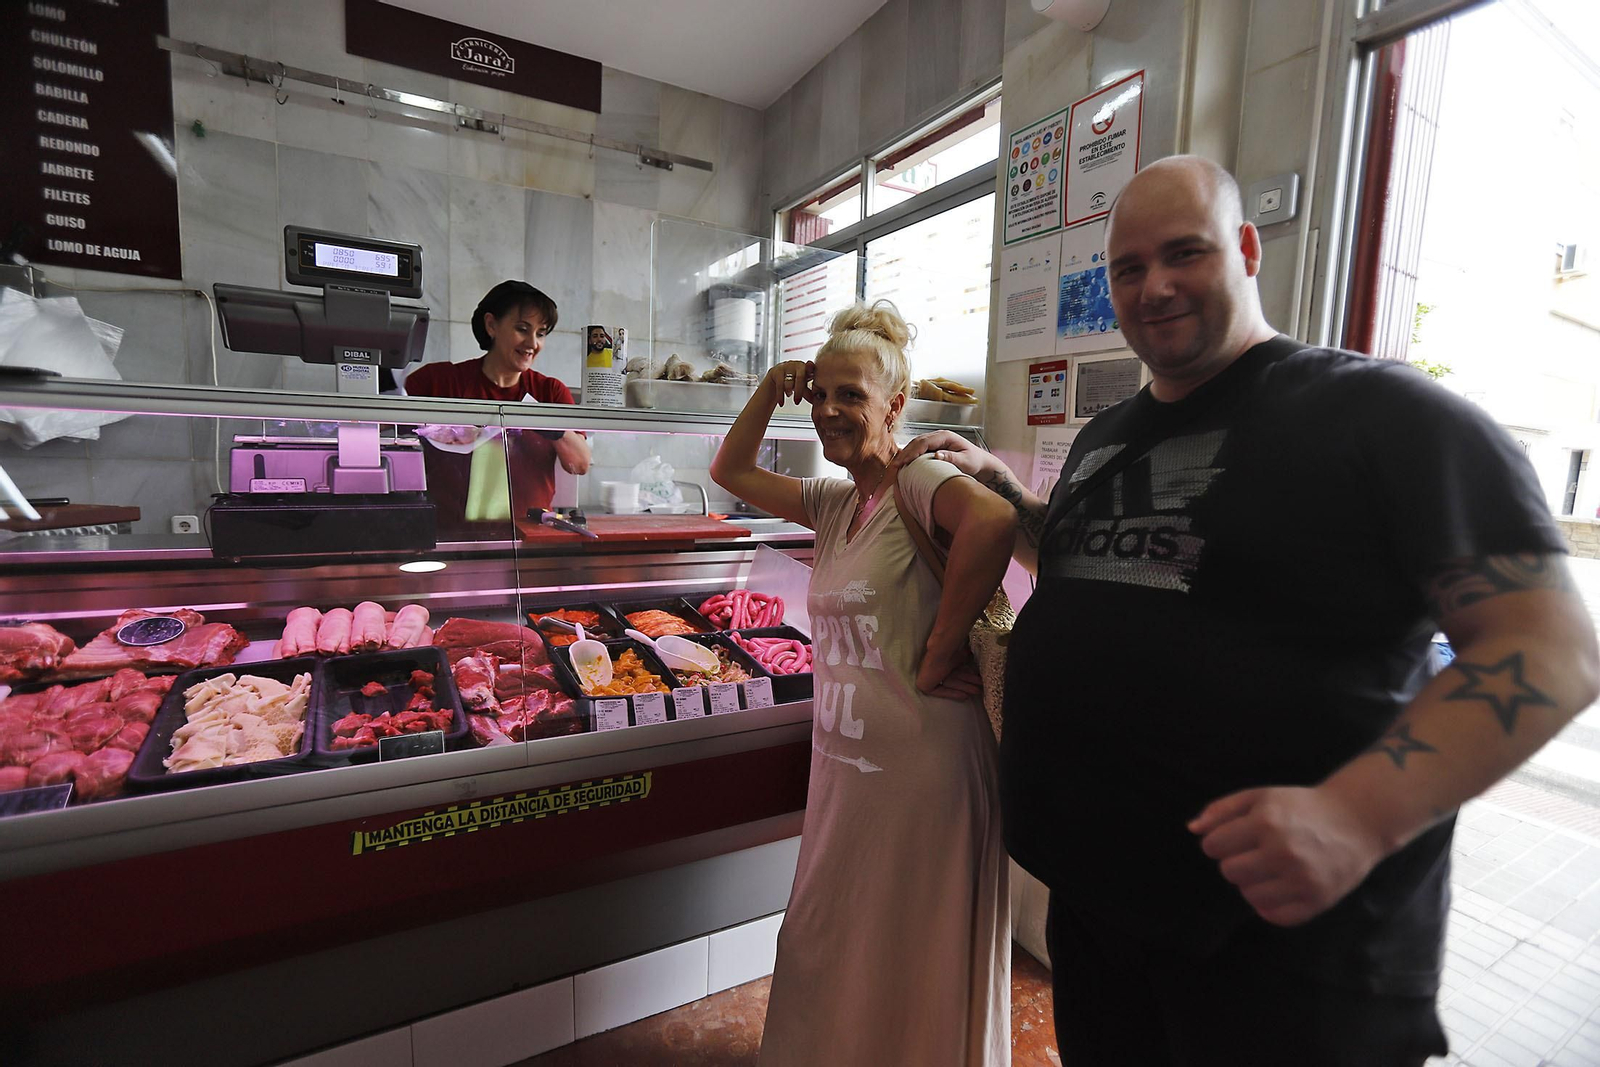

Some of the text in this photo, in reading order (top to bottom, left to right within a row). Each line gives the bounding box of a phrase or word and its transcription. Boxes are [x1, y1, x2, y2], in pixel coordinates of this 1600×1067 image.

[28, 2, 66, 22] LOMO
[31, 29, 98, 55] CHULETÓN
[464, 48, 501, 67] Jara
[33, 55, 104, 82] SOLOMILLO
[35, 82, 89, 104] BABILLA
[37, 109, 89, 130] CADERA
[39, 135, 100, 157] REDONDO
[1079, 129, 1127, 152] PROHIBIDO FUMAR
[1091, 141, 1113, 154] EN ESTE
[1079, 142, 1126, 165] ESTABLECIMIENTO
[42, 162, 95, 181] JARRETE
[44, 188, 91, 205] FILETES
[46, 214, 86, 230] GUISO
[48, 239, 141, 262] LOMO DE AGUJA
[333, 248, 355, 257] 0850
[333, 256, 355, 264] 0000
[344, 351, 371, 360] DIBAL
[814, 613, 885, 671] PPIE
[814, 674, 865, 741] UL
[368, 780, 642, 845] MANTENGA LA DISTANCIA DE SEGURIDAD
